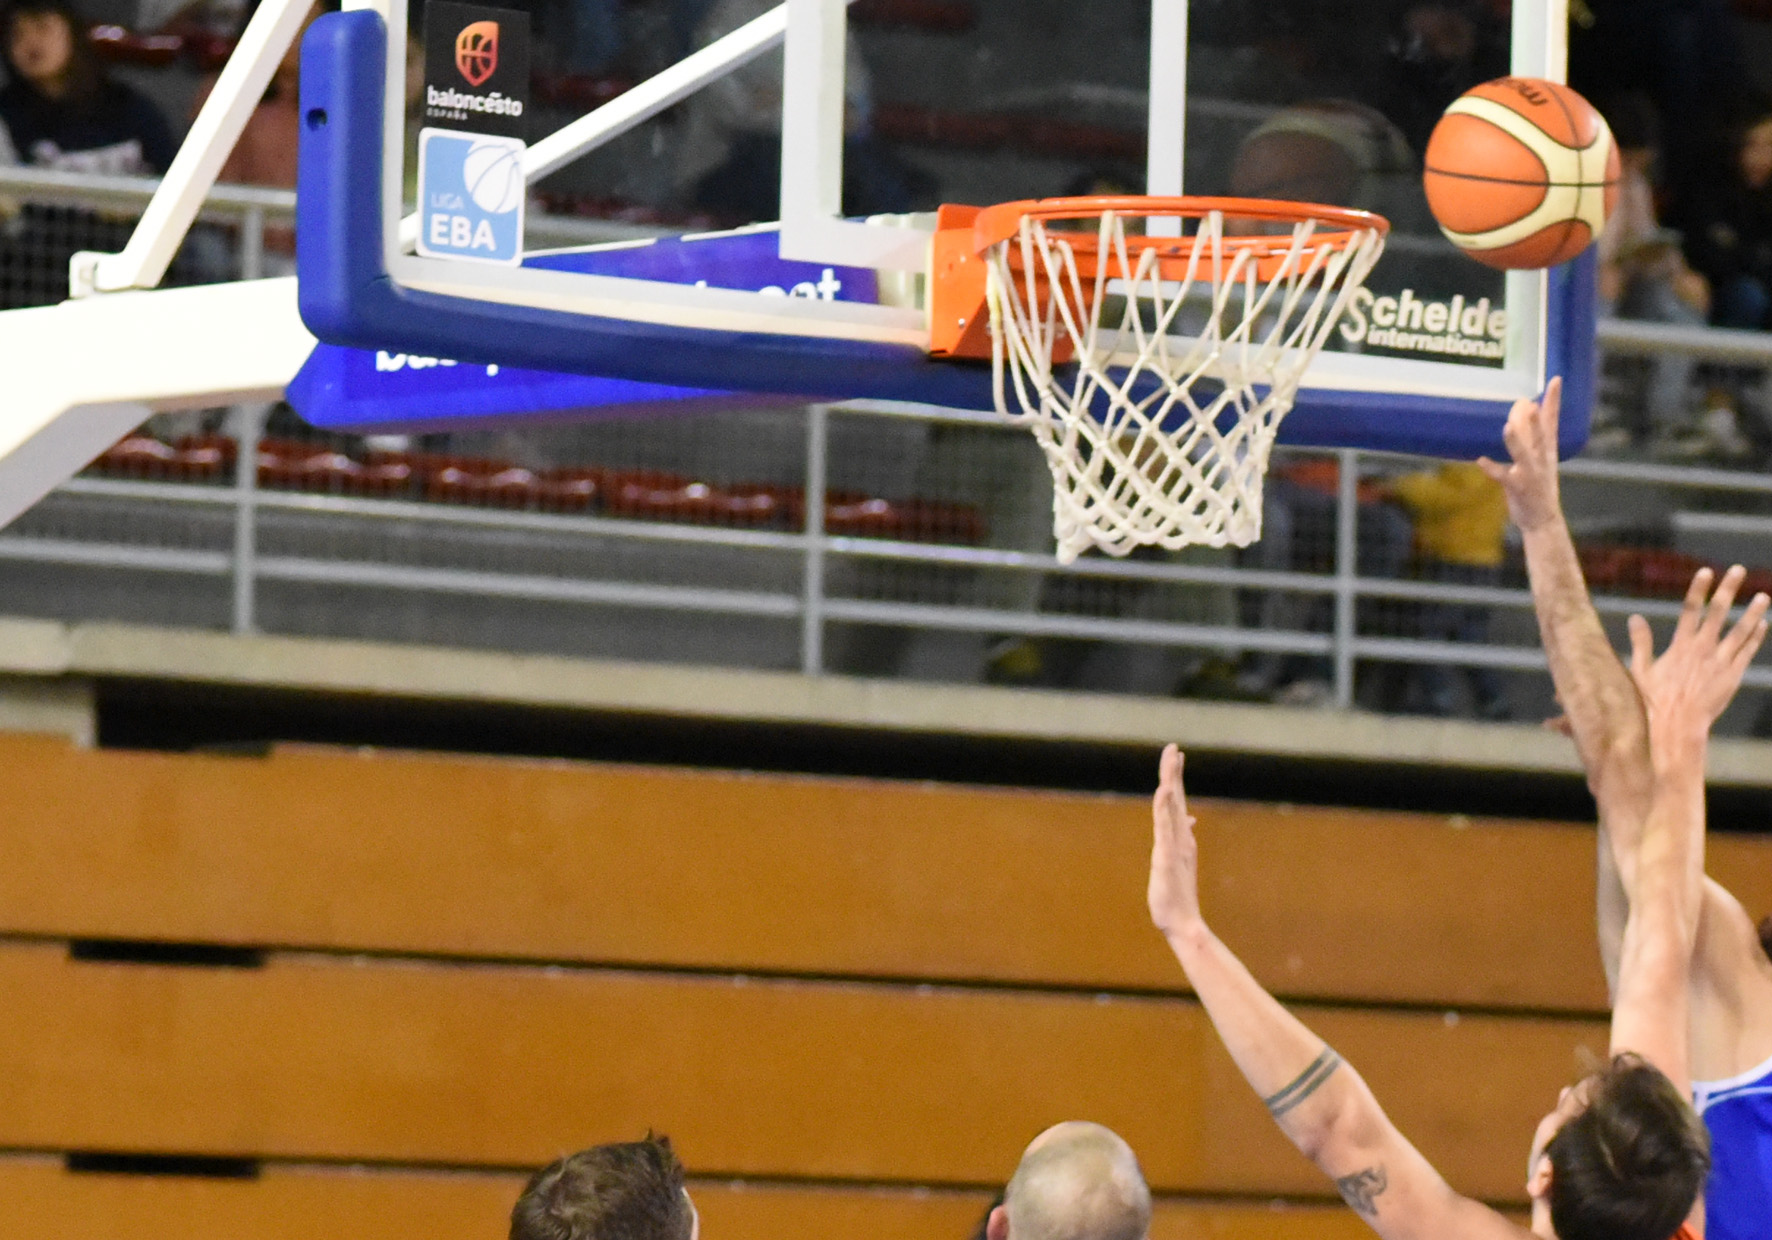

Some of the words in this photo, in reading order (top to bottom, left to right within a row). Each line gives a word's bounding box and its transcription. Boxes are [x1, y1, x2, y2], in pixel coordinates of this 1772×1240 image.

[430, 192, 464, 210] LIGA
[430, 213, 496, 252] EBA
[1339, 286, 1507, 342] Schelde
